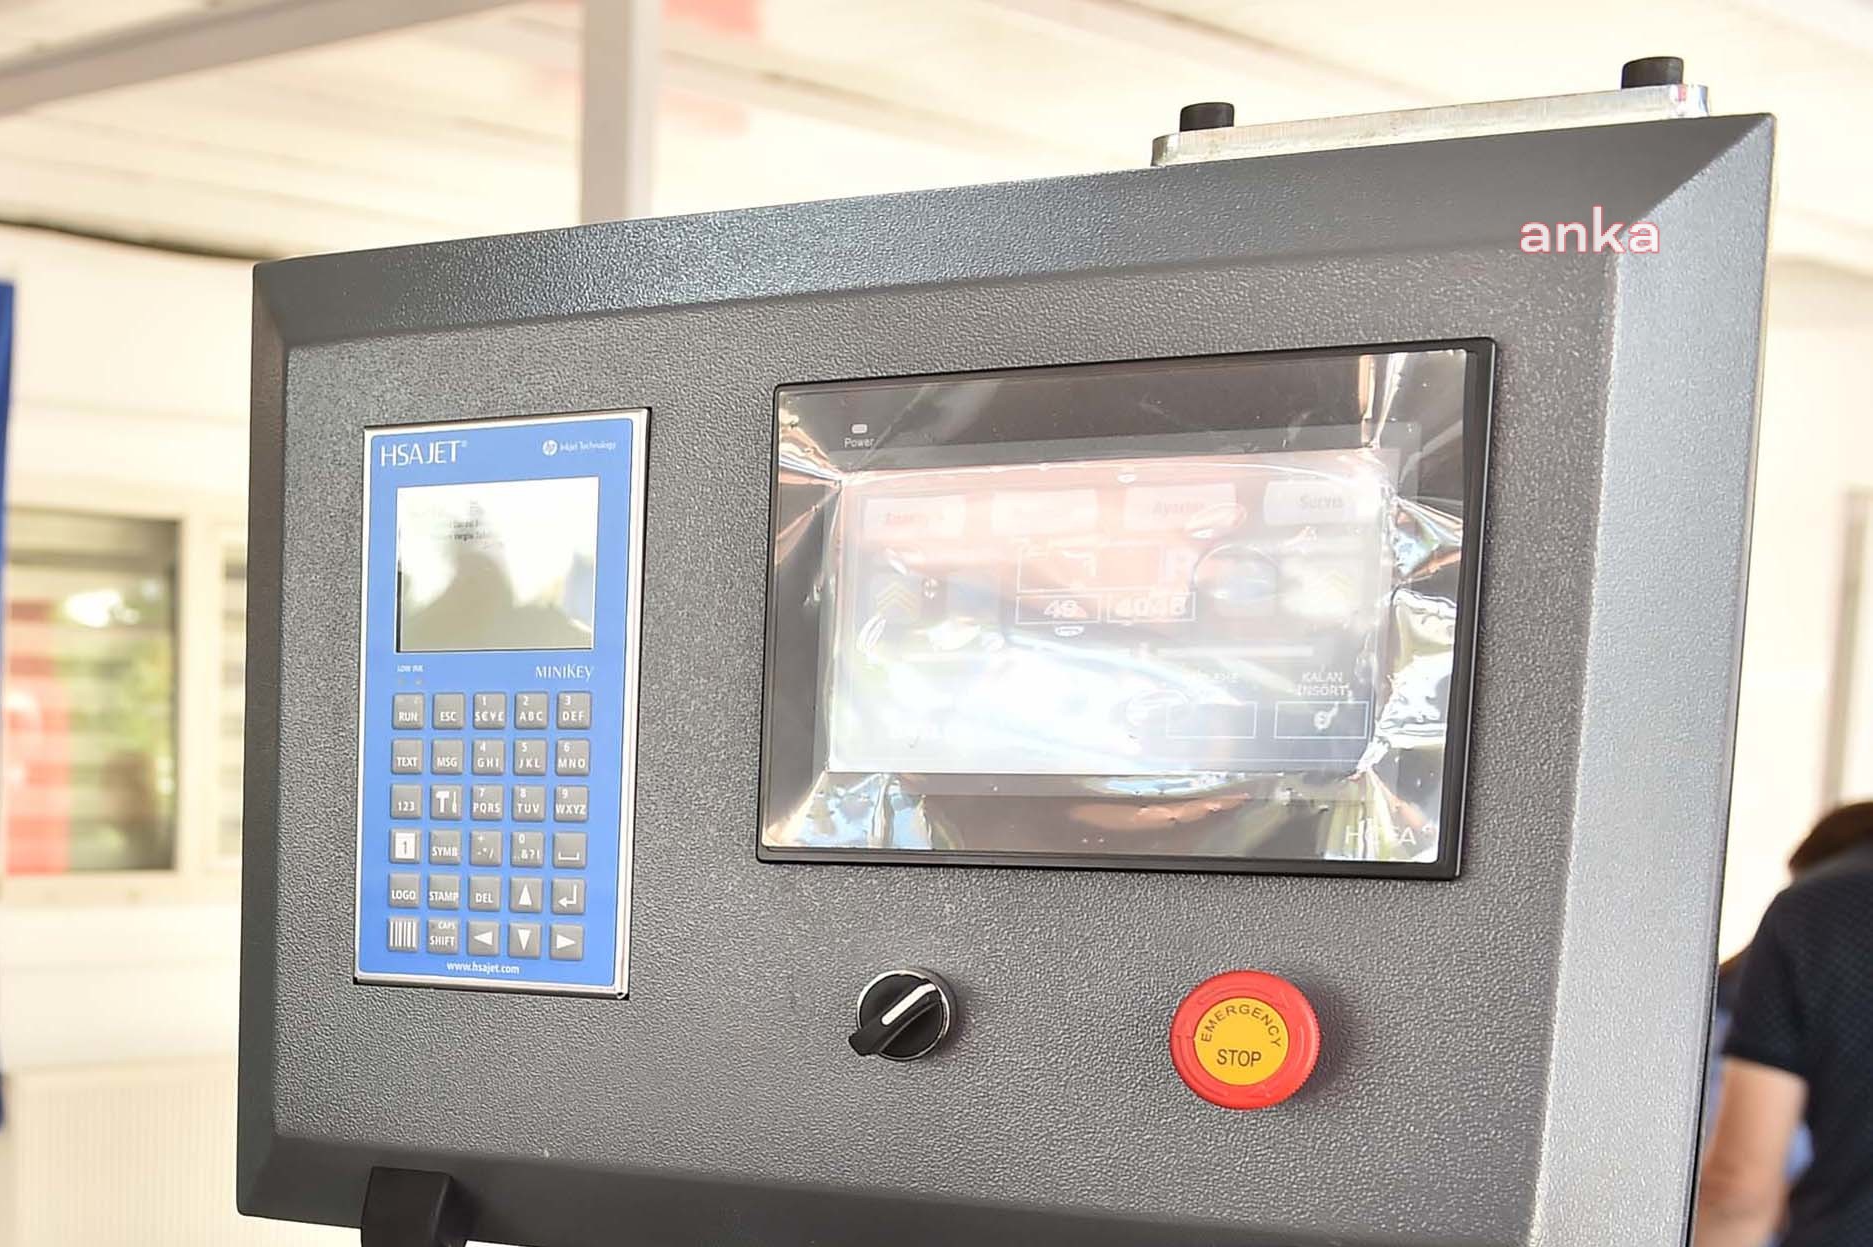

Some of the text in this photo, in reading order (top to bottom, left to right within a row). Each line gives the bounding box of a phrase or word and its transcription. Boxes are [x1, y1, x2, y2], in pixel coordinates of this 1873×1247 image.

[844, 437, 874, 449] Power
[380, 440, 460, 467] HSAJET
[399, 712, 418, 721] RUN
[440, 712, 457, 721] ESC
[396, 757, 417, 767] TEXT
[437, 757, 458, 767] MSG
[398, 802, 415, 811] 123
[473, 803, 501, 814] PQRS
[555, 804, 586, 815] WXYZ
[432, 846, 458, 857] SYMB
[391, 890, 416, 900] LOGO
[429, 891, 459, 902] STAMP
[475, 892, 493, 903] DEL
[438, 921, 456, 930] CAPS
[429, 935, 455, 946] SHIFT
[446, 961, 520, 974] www.hsajet.com
[1201, 1003, 1282, 1047] EMERGENCY
[1216, 1049, 1262, 1067] STOP
